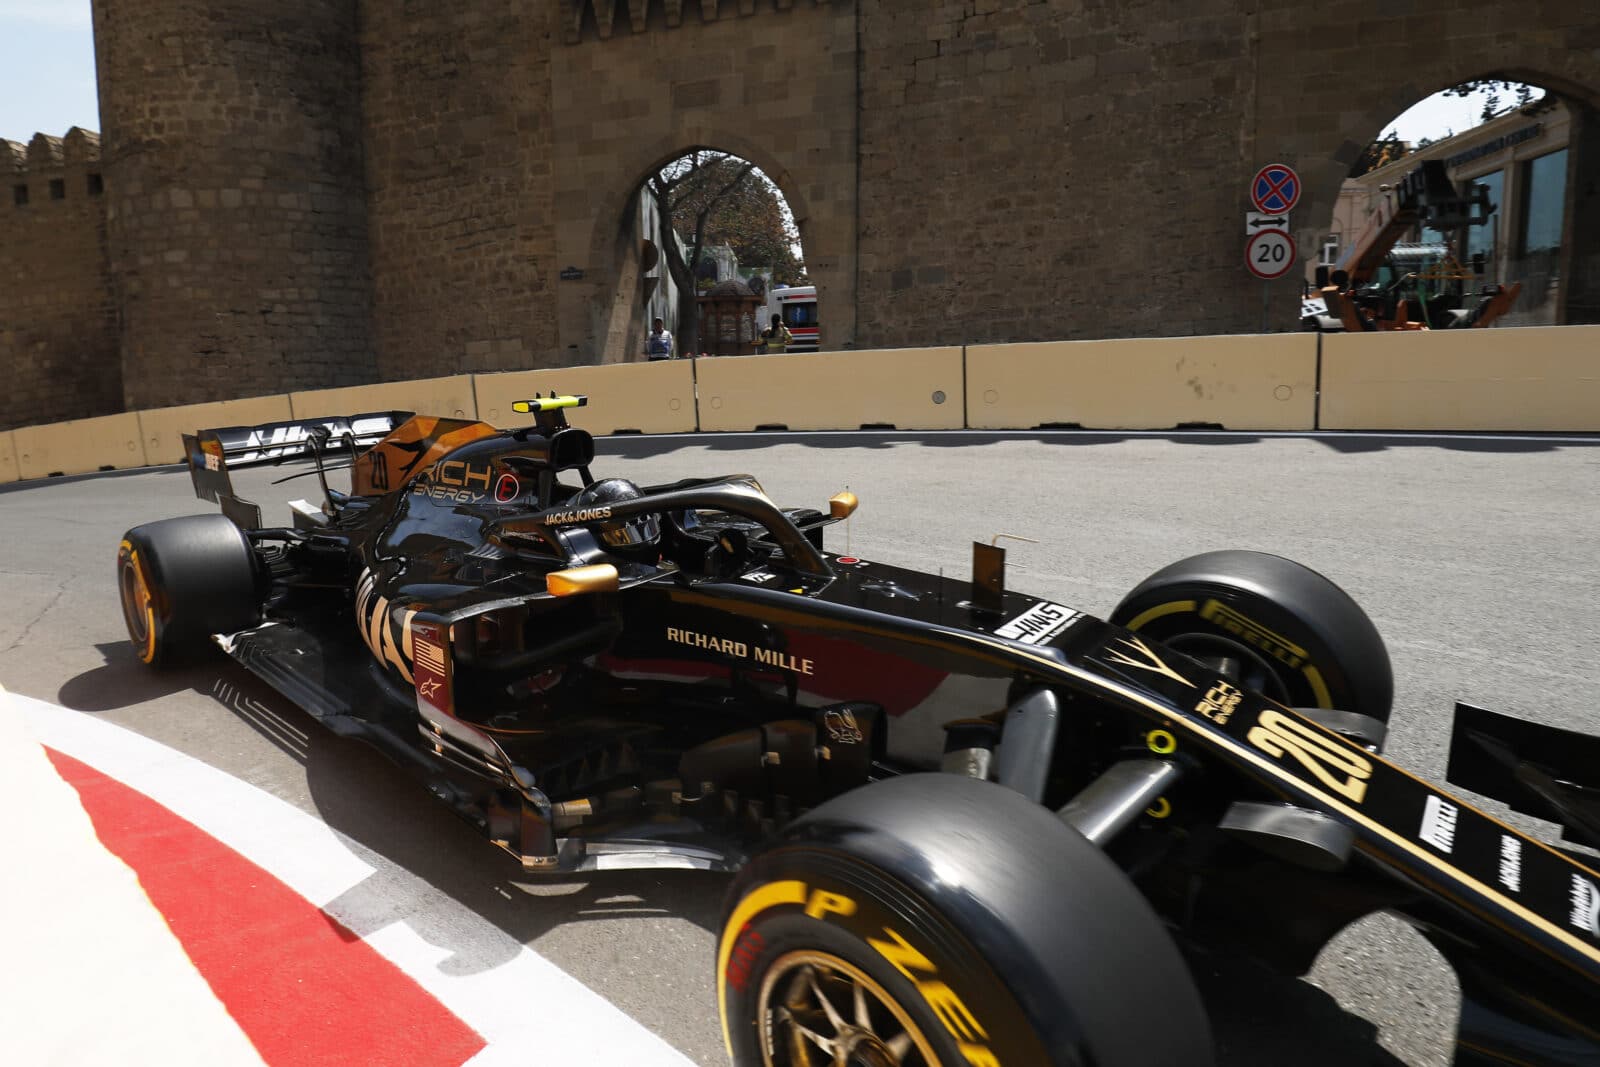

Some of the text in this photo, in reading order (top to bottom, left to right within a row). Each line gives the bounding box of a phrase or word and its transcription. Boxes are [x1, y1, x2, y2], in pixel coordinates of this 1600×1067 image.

[1257, 243, 1285, 263] 20
[368, 450, 389, 491] 20
[413, 483, 486, 504] ENERGY
[544, 506, 612, 526] JACK&JONES
[667, 627, 815, 676] RICHARD MILLE
[1247, 709, 1374, 804] 20
[805, 889, 857, 920] P
